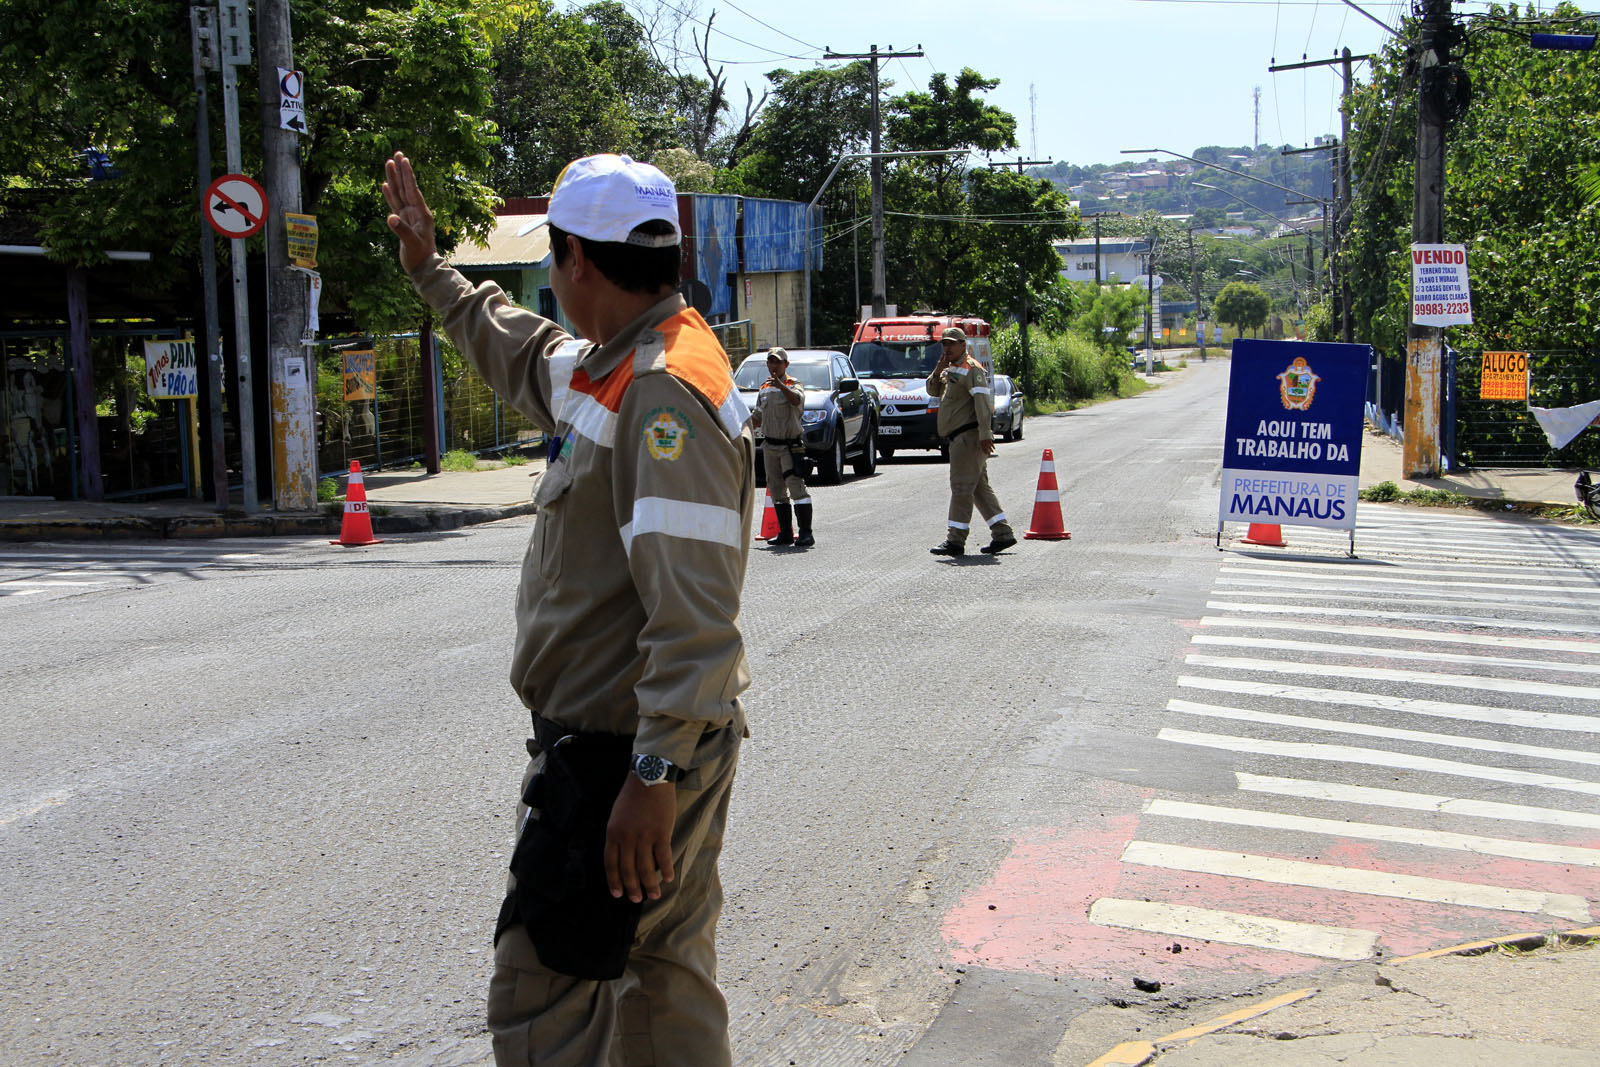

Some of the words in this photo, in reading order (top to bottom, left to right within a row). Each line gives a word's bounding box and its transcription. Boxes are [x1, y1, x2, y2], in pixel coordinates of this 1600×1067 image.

[1412, 250, 1464, 265] VENDO
[1420, 267, 1441, 275] TERRENO
[1414, 302, 1469, 316] 99983-2233
[1483, 354, 1526, 372] ALUGO
[1483, 373, 1525, 381] APARTAMENTOS
[1256, 419, 1296, 438] AQUI
[1301, 422, 1331, 440] TEM
[1236, 438, 1322, 461] TRABALHO
[1326, 443, 1349, 462] DA
[1234, 478, 1321, 497] PREFEITURA
[1326, 483, 1347, 498] DE
[1229, 493, 1346, 520] MANAUS
